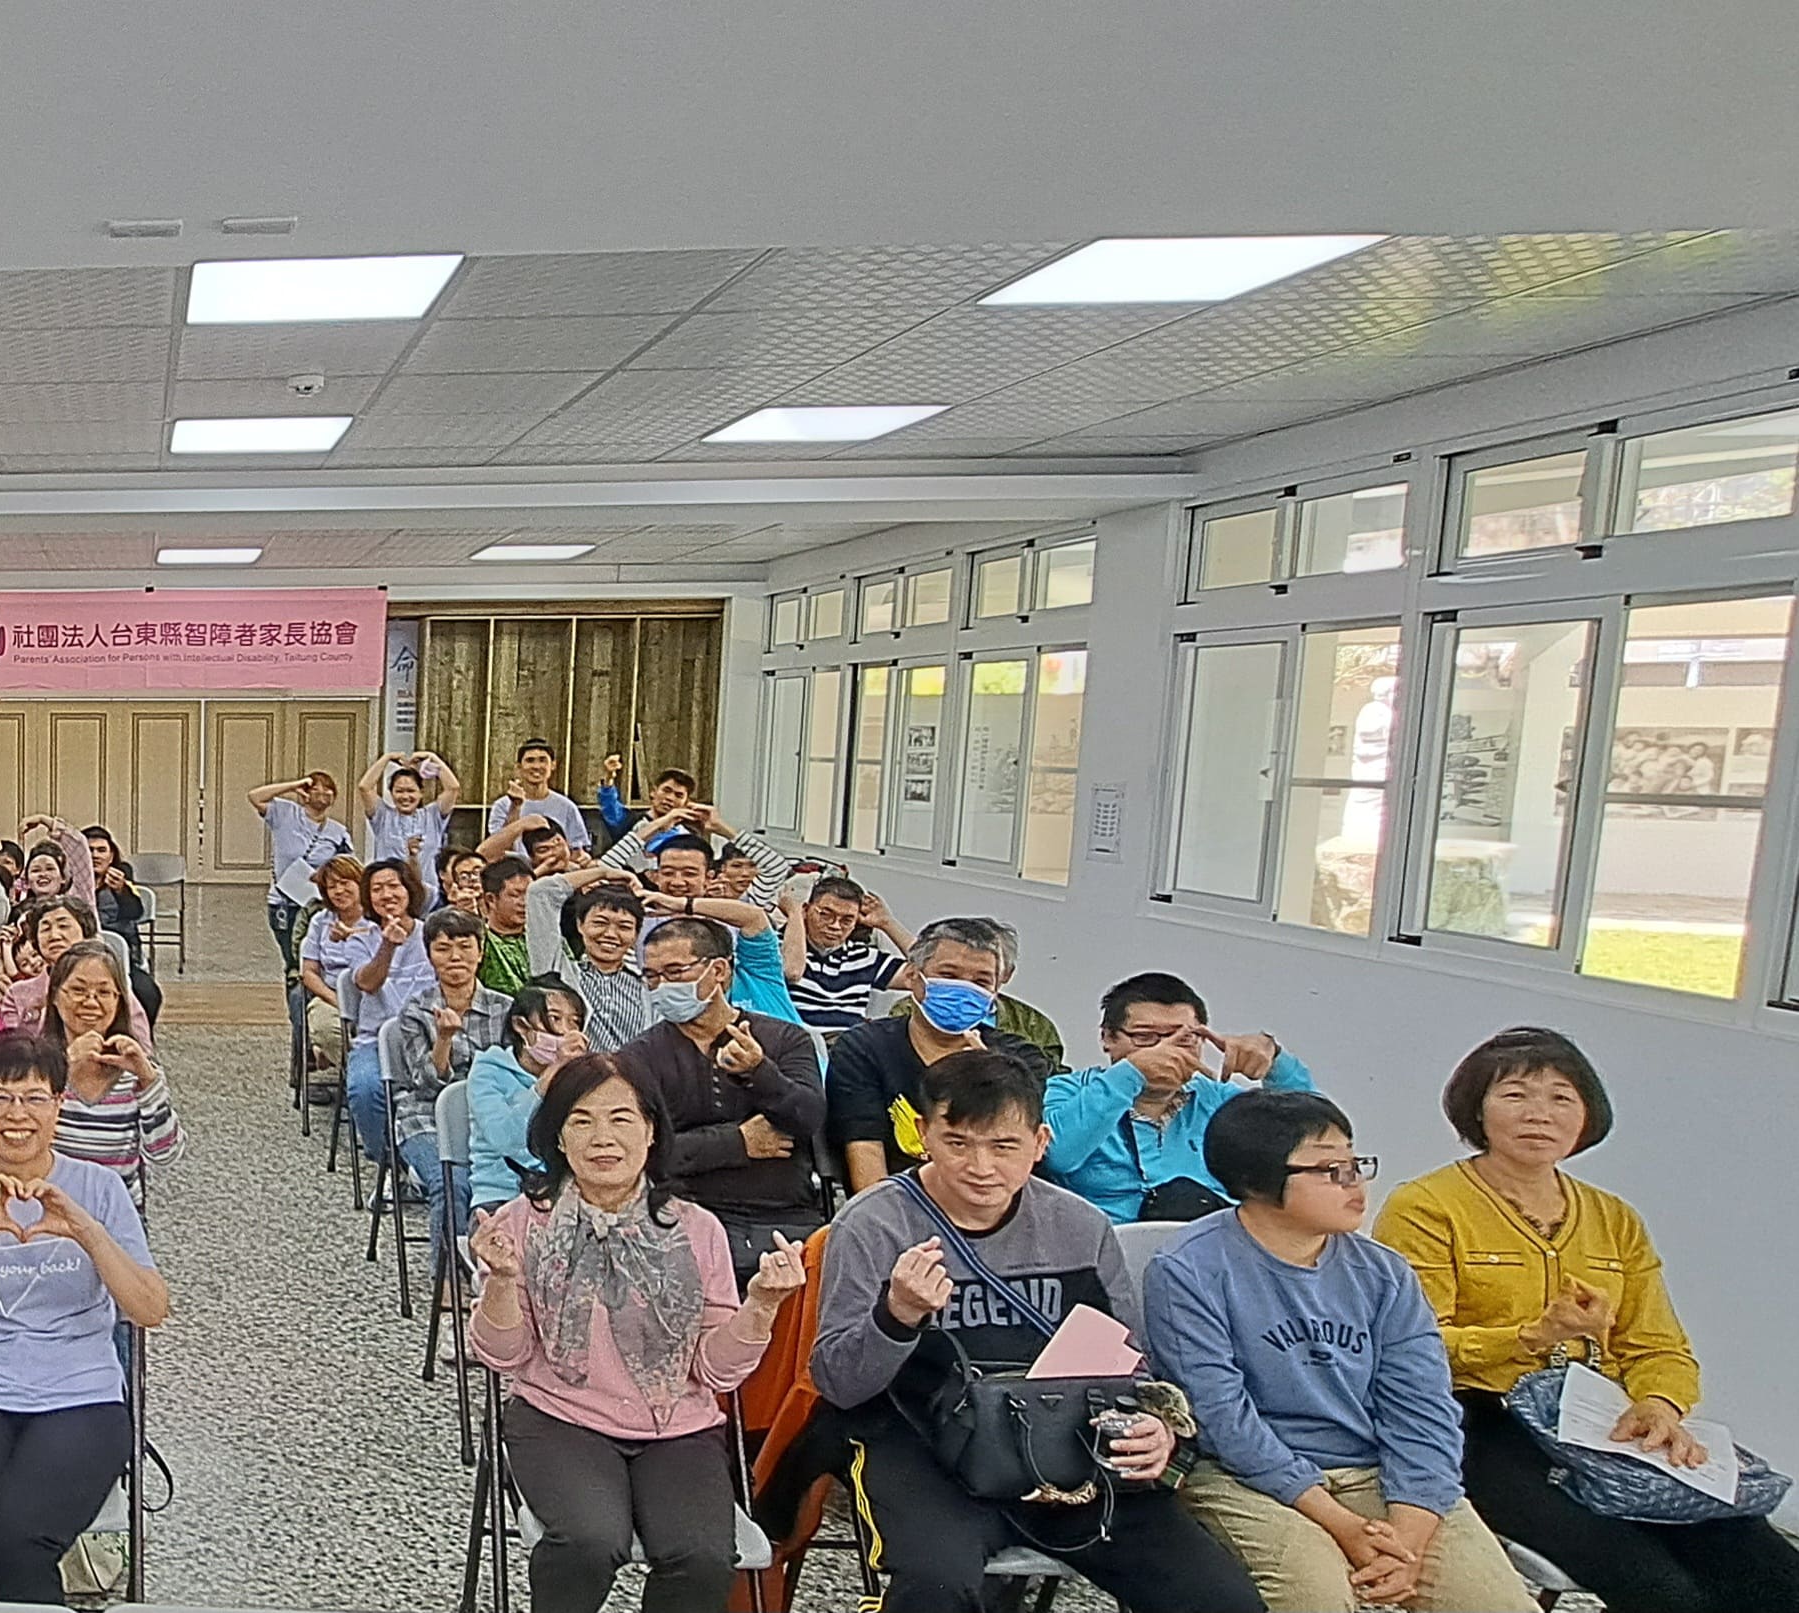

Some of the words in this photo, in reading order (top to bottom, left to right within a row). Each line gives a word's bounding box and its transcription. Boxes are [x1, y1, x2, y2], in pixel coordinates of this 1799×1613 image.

[12, 620, 358, 649] 社團法人台東縣智障者家長協會
[53, 653, 106, 663] Association
[107, 653, 121, 663] for
[122, 653, 161, 662] Persons
[320, 652, 353, 663] County
[0, 1265, 36, 1278] your
[40, 1257, 81, 1274] back!
